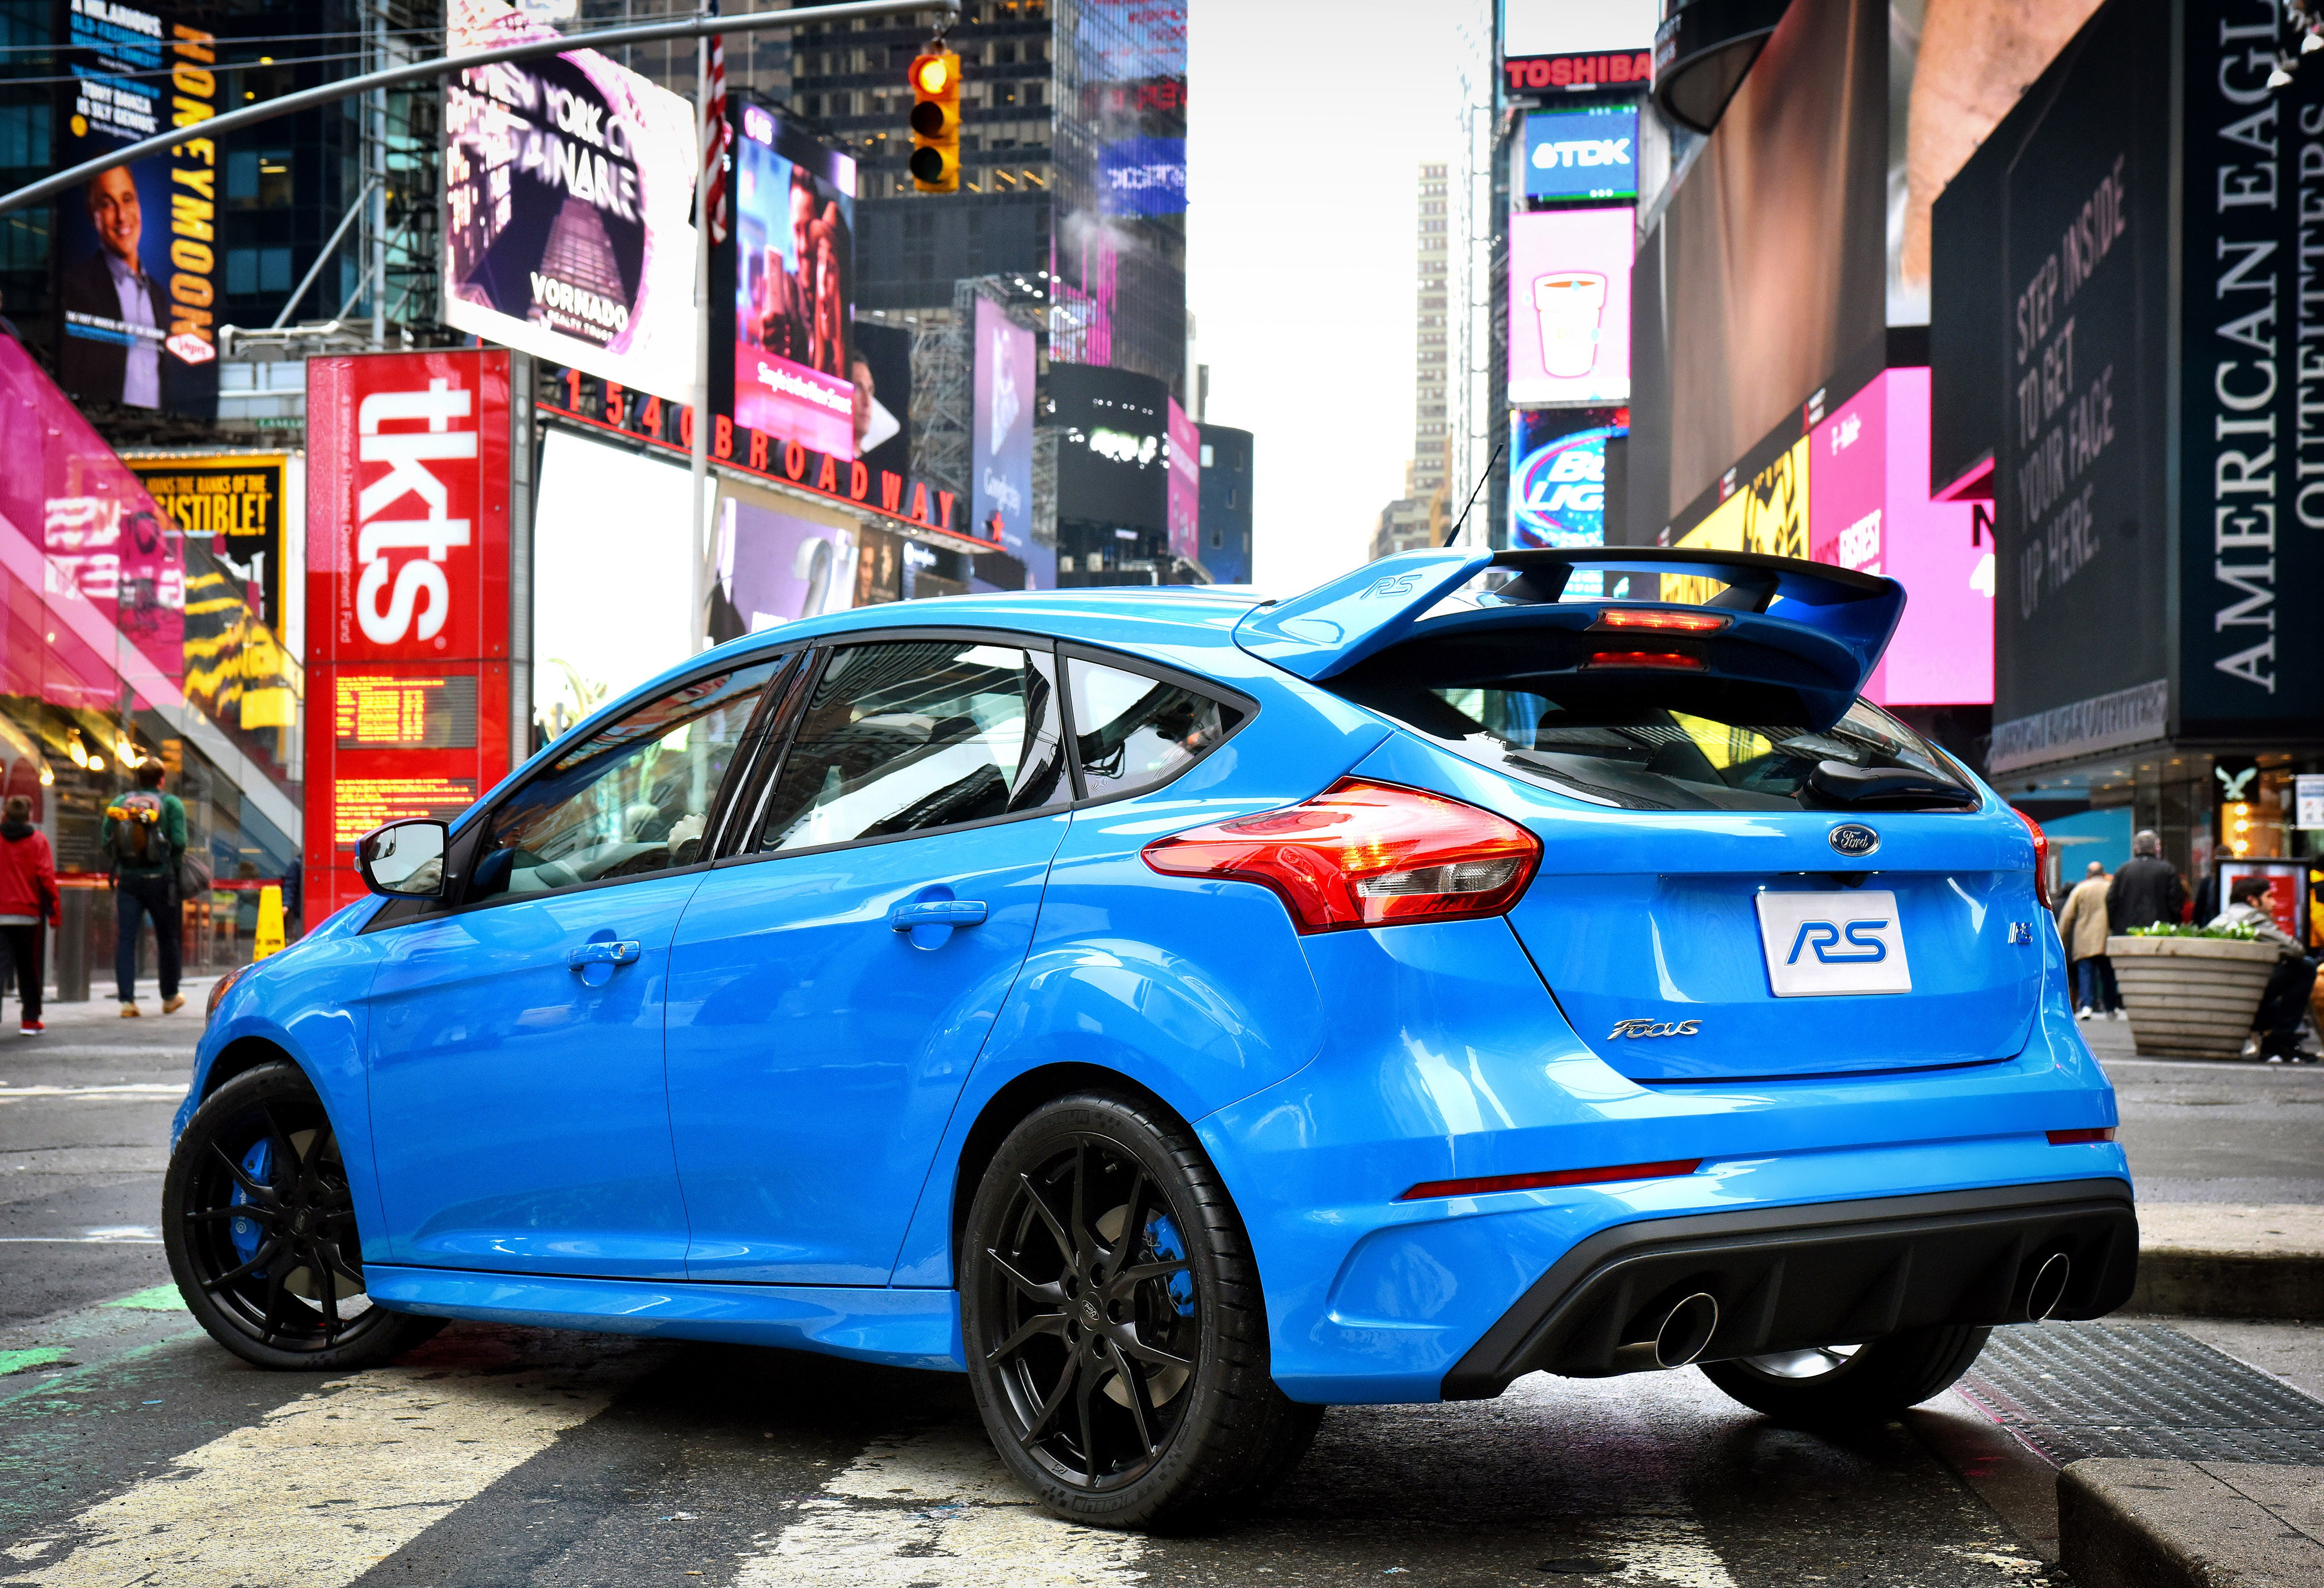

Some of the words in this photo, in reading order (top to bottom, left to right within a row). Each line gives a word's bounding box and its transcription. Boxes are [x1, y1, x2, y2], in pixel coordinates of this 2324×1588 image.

[1505, 52, 1651, 89] TOSHIBA
[2218, 0, 2279, 214] EAGL
[170, 23, 216, 342] HONEYMOON
[1554, 138, 1631, 168] TDK
[2017, 253, 2059, 365] STEP
[2062, 153, 2126, 305] INSIDE
[530, 271, 629, 332] VORNADO
[2018, 366, 2039, 450] TO
[2043, 315, 2076, 421] GET
[565, 368, 694, 448] 1540
[715, 414, 954, 529] BROADWAY
[1547, 450, 1605, 482] BU
[2018, 427, 2065, 535] YOUR
[2068, 364, 2116, 482] FACE
[2214, 235, 2278, 694] AMERICAN
[356, 377, 478, 646] tkts
[1525, 481, 1605, 511] LIG
[1839, 508, 1881, 570] FASTEST
[1359, 573, 1423, 600] RS
[2019, 538, 2043, 622] UP
[340, 610, 353, 645] Fund
[1840, 829, 1870, 851] Ford
[1784, 917, 1892, 966] RS
[1072, 1490, 1140, 1514] MICHELIN
